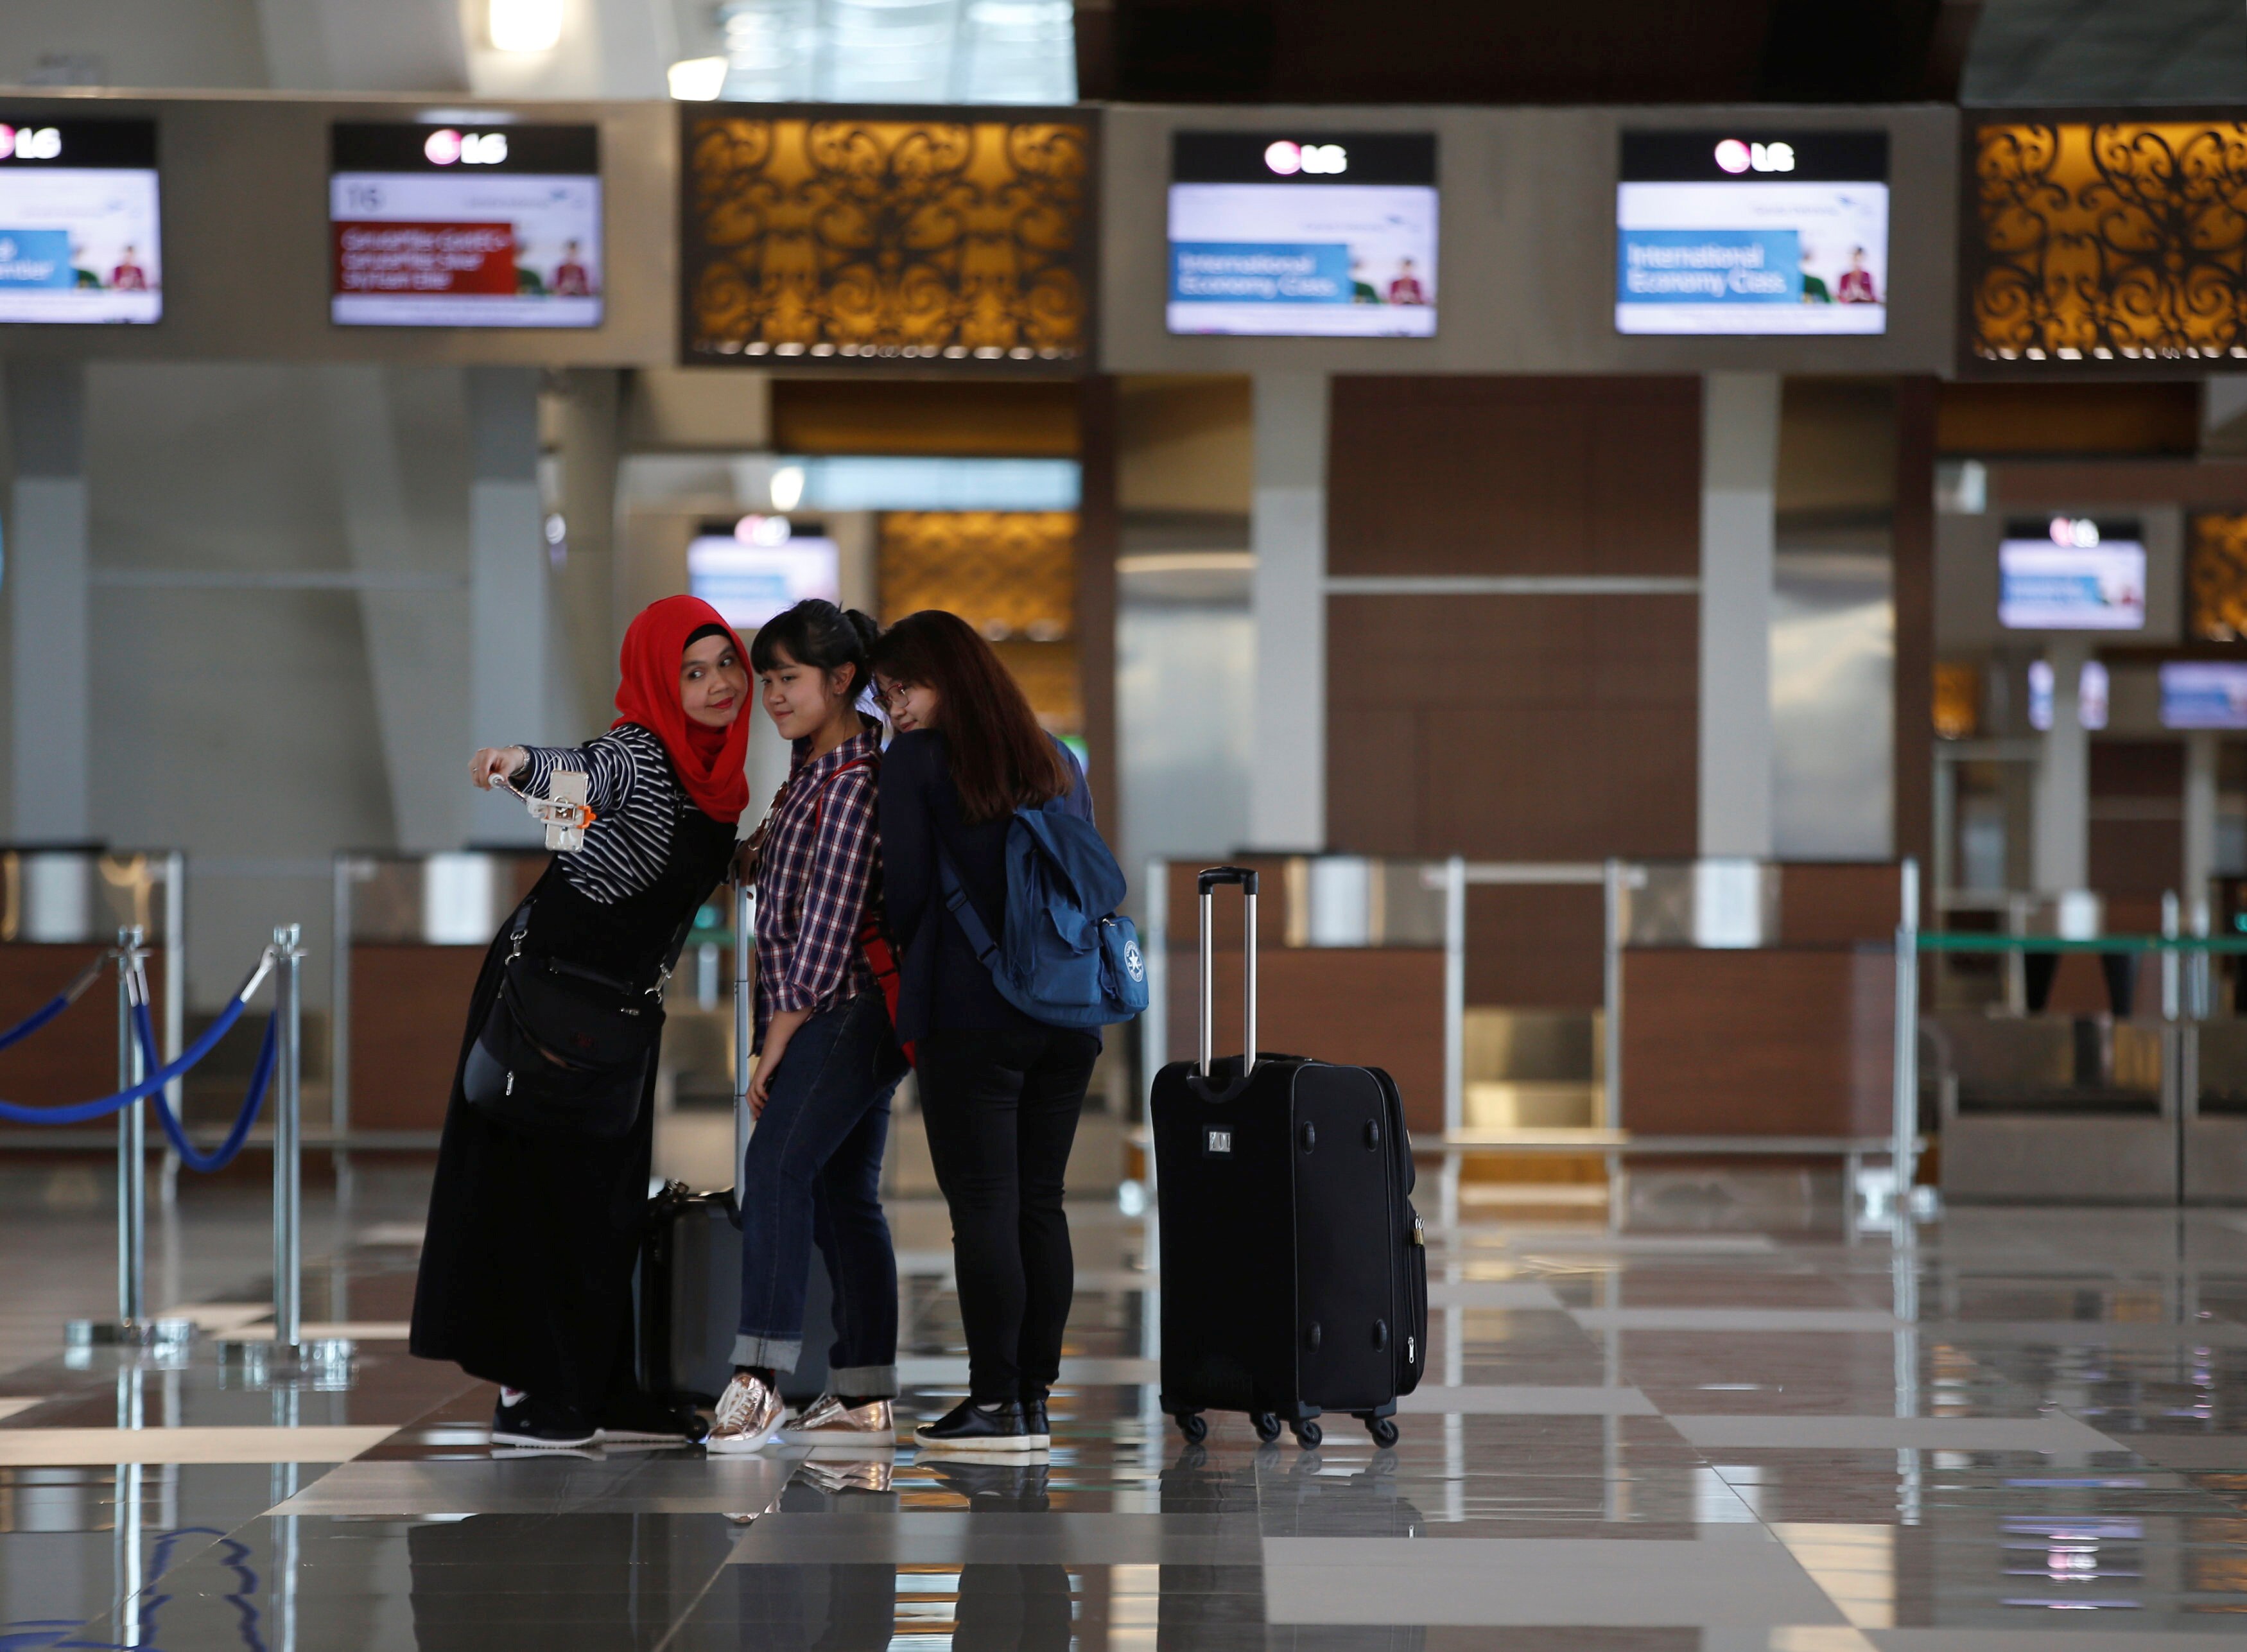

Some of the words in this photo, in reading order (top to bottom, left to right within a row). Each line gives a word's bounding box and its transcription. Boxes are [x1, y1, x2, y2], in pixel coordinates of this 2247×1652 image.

[15, 128, 62, 159] LG
[460, 133, 508, 164] LG
[1751, 142, 1795, 171] LG
[1301, 144, 1348, 174] LG
[1627, 243, 1764, 268] International
[1627, 270, 1726, 297] Economy
